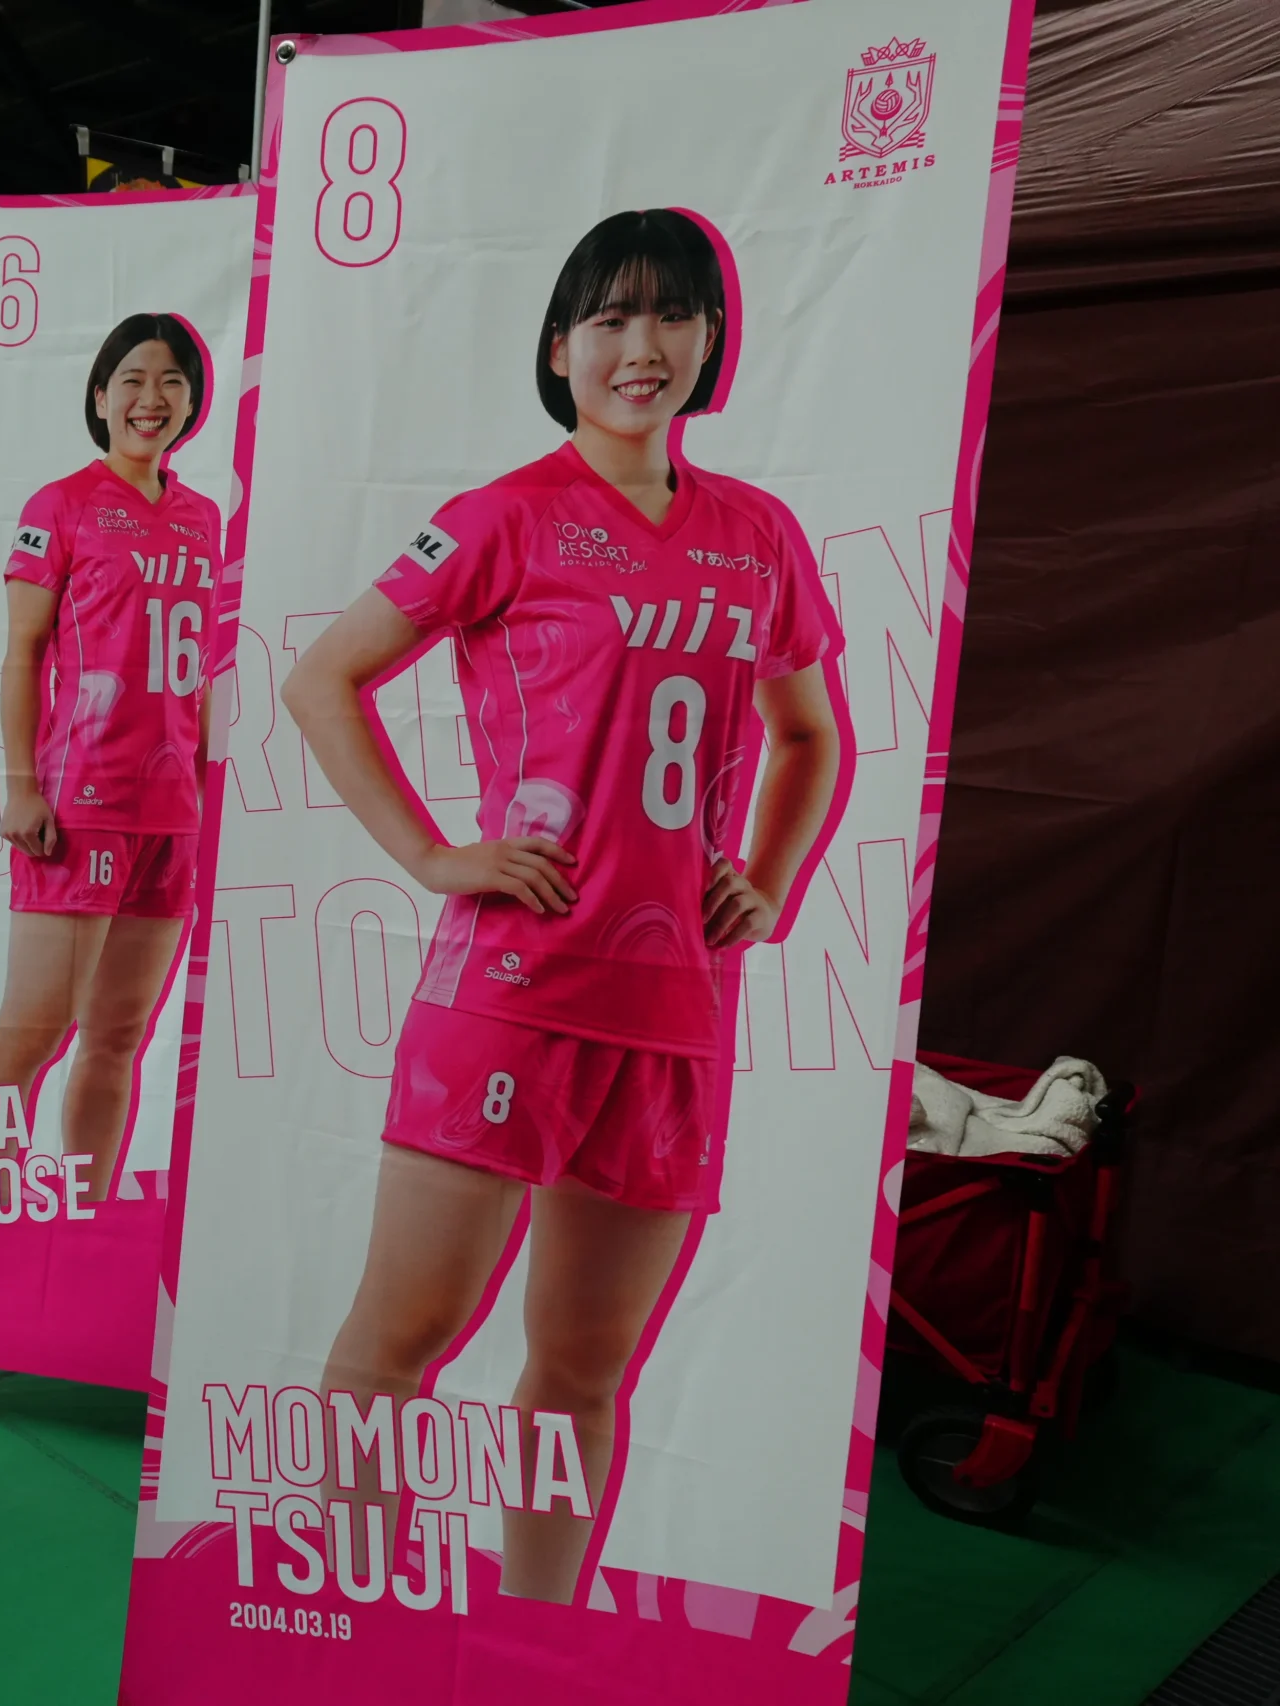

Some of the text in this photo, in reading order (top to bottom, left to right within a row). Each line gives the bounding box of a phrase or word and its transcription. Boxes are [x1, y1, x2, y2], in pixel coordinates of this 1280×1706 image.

[315, 96, 407, 267] 8
[823, 154, 936, 185] ARTEMIS
[852, 176, 903, 189] HOKKAIDO
[97, 516, 140, 530] RESORT
[558, 539, 629, 561] RESORT
[145, 598, 203, 698] 16
[642, 675, 707, 831] 8
[72, 796, 103, 806] Squadra
[89, 849, 114, 886] 16
[484, 966, 531, 986] Squadra
[482, 1071, 515, 1124] 8
[202, 1383, 595, 1520] MOMONA
[216, 1490, 470, 1617] TSUJI
[229, 1602, 353, 1642] 2004.03.19
